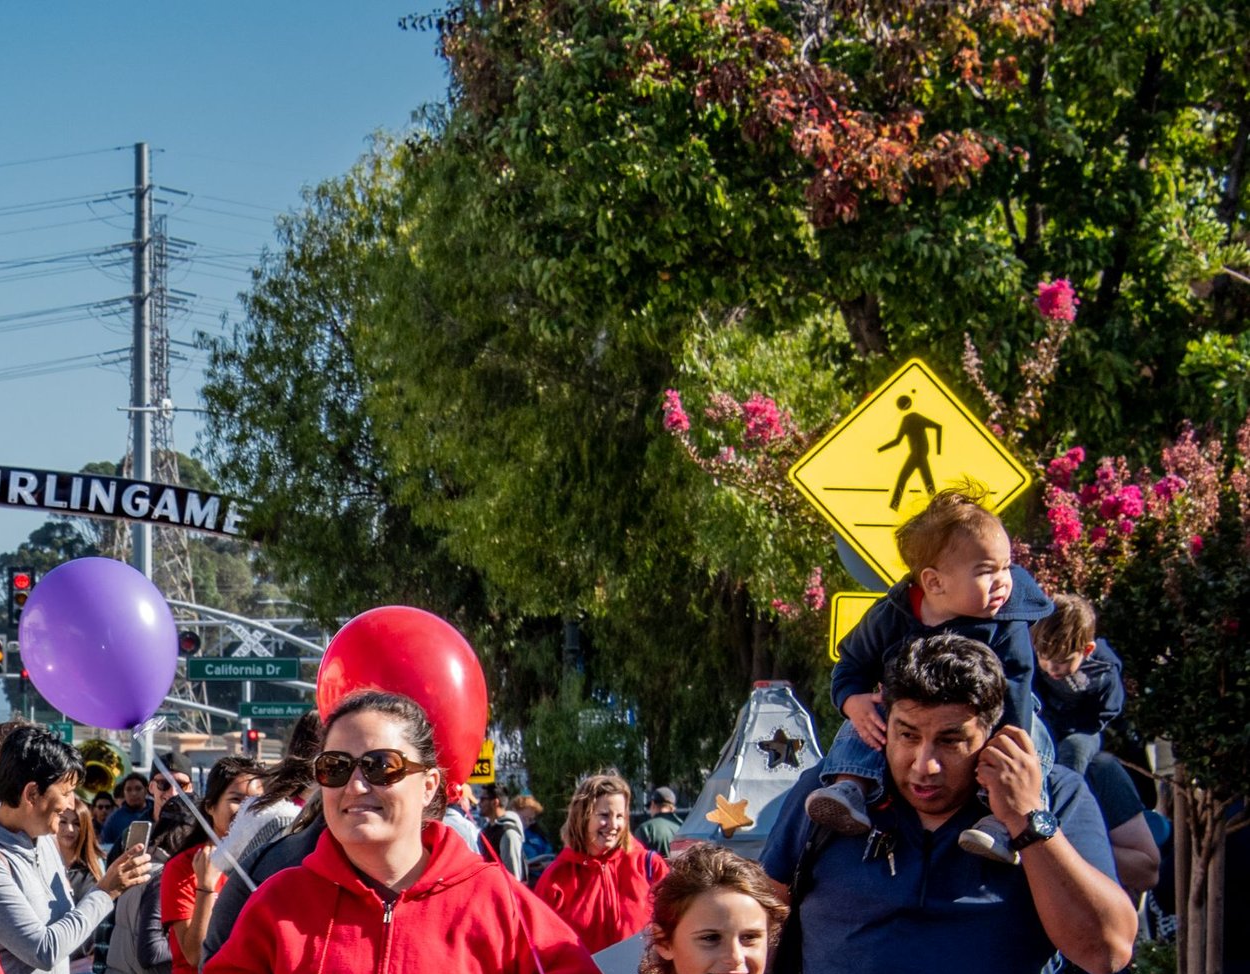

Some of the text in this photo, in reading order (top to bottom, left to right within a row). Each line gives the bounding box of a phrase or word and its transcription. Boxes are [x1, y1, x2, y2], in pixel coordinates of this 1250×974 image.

[205, 664, 281, 675] California Dr
[286, 706, 303, 714] Ave
